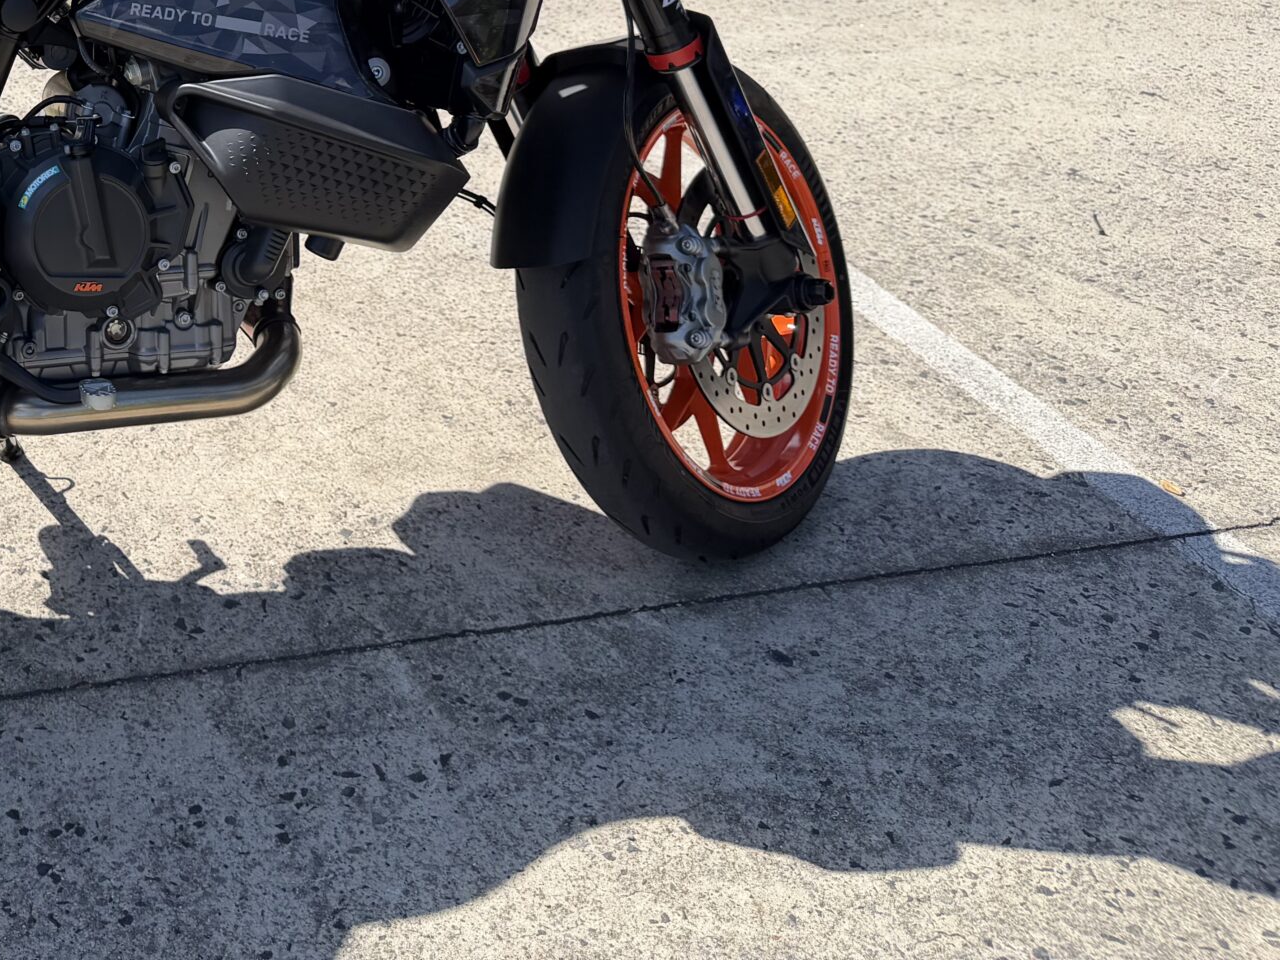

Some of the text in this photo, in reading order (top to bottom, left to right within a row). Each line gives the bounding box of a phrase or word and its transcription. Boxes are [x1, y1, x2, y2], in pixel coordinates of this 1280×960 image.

[129, 2, 311, 43] READY TO RACE
[779, 149, 801, 180] RACE
[25, 166, 57, 197] MOTOREX
[74, 281, 104, 292] KTM
